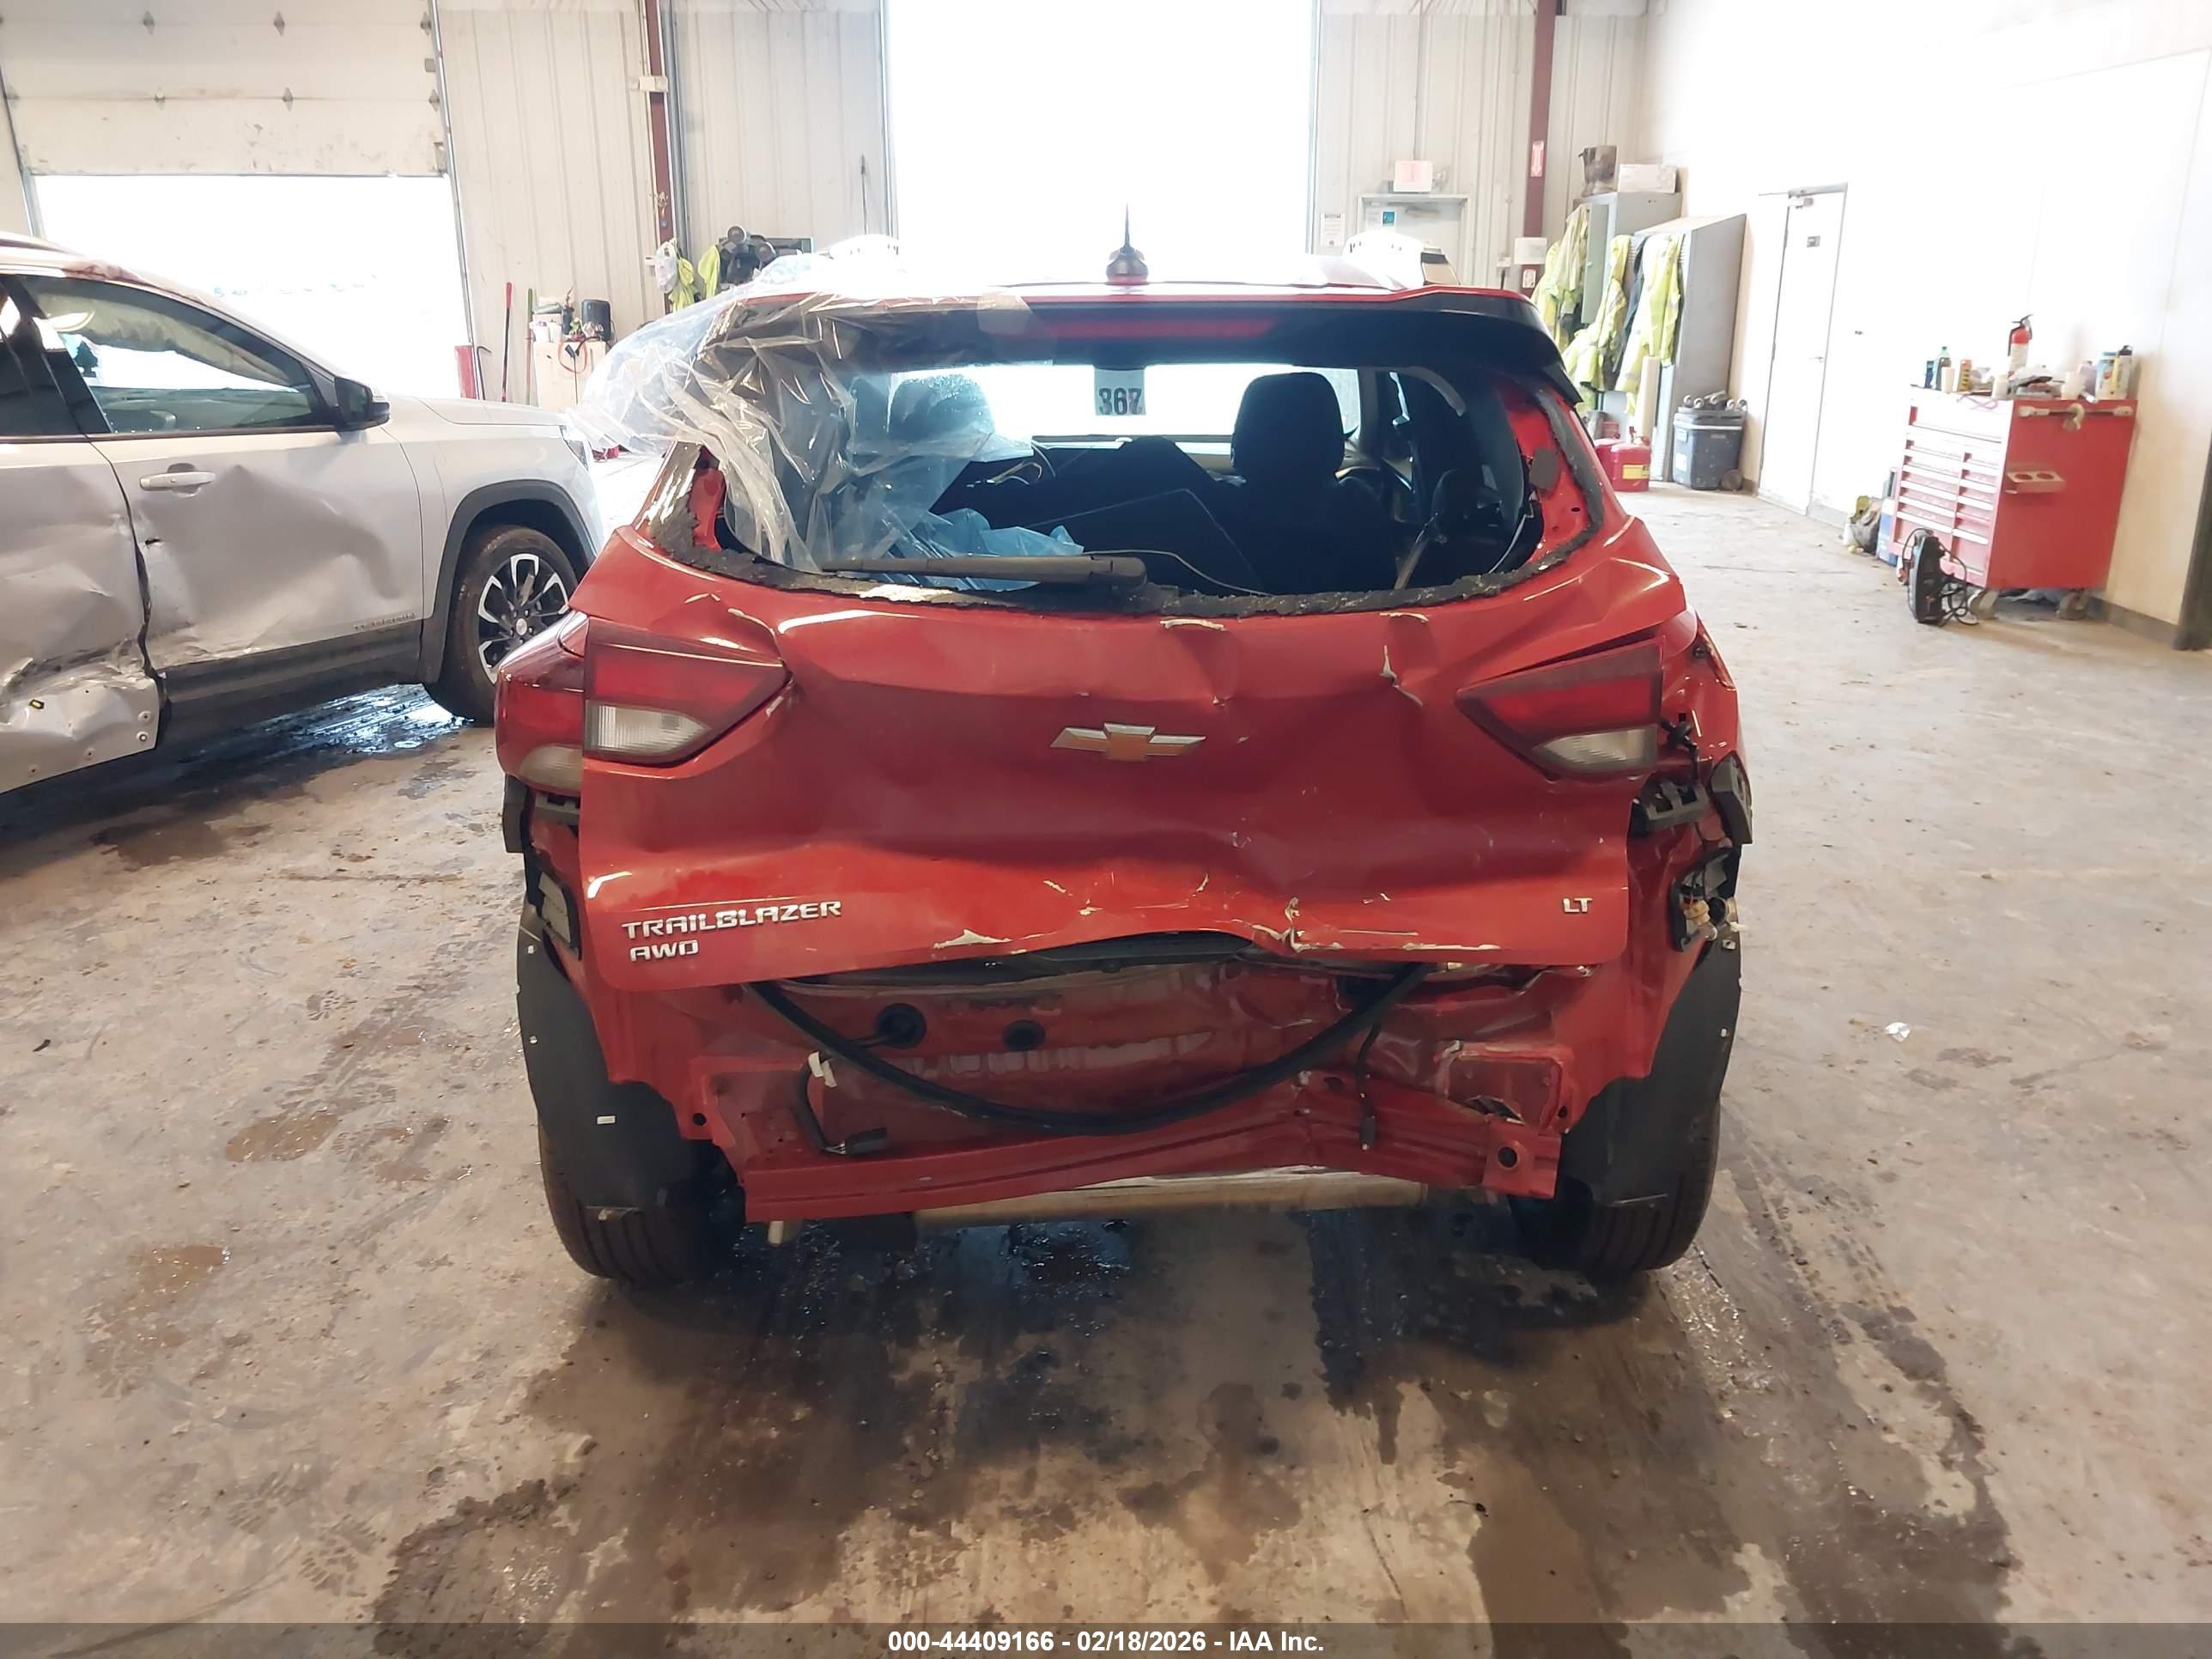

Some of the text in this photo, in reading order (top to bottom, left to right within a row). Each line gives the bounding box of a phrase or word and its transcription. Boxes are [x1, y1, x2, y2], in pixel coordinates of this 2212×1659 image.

[1098, 387, 1142, 416] 367
[1562, 897, 1594, 914] LT
[622, 901, 842, 939] TRAILBLAZER
[629, 939, 699, 962] AWD
